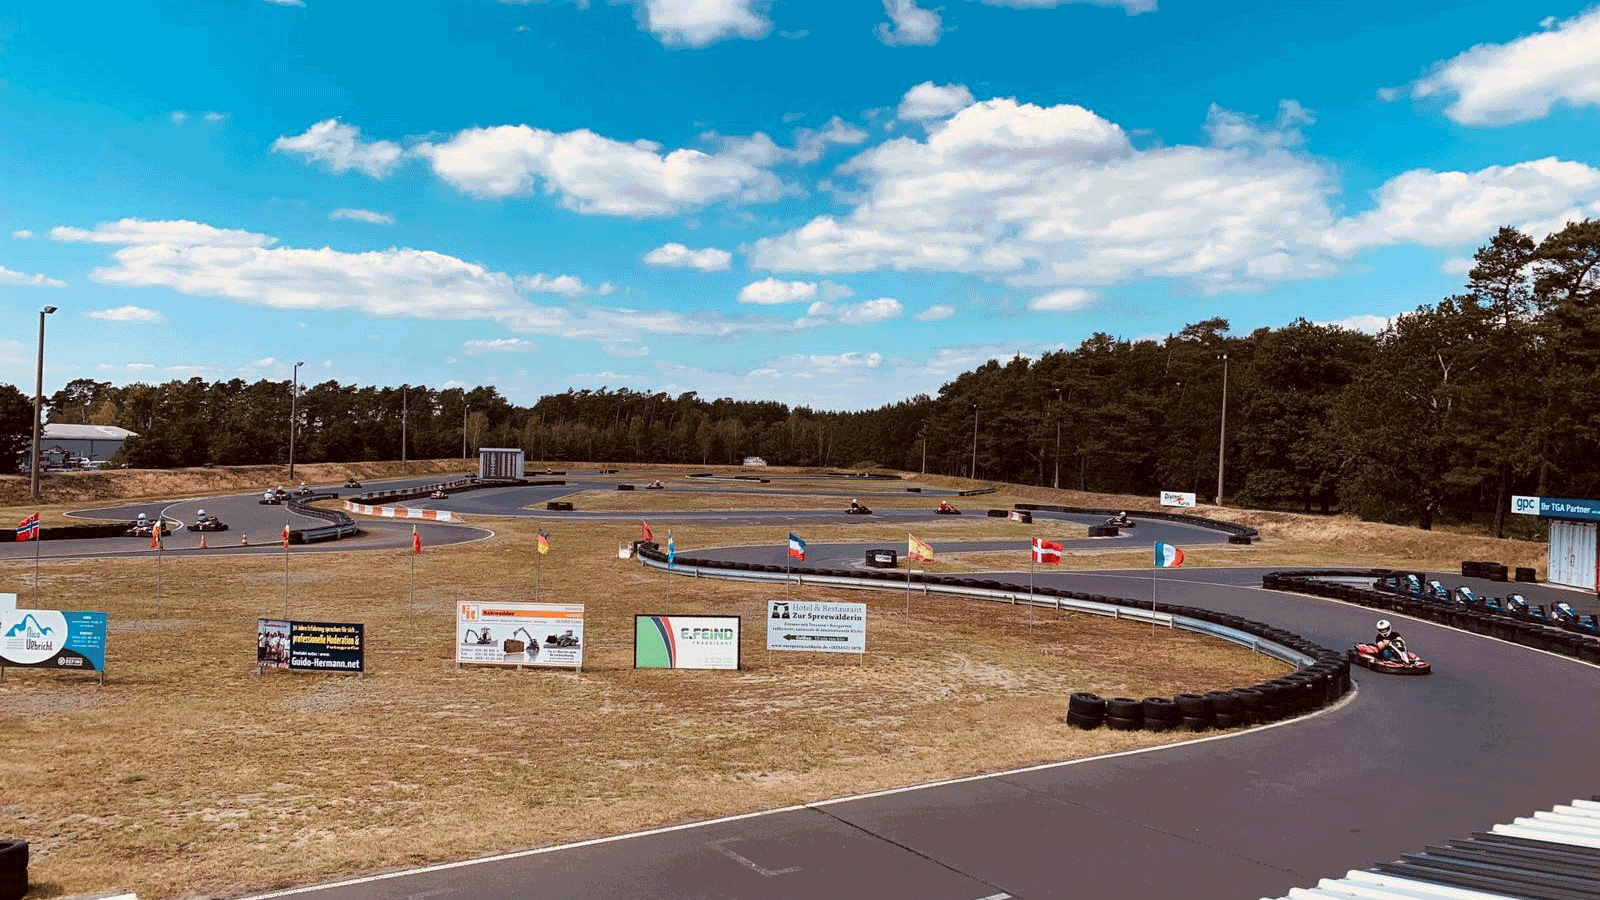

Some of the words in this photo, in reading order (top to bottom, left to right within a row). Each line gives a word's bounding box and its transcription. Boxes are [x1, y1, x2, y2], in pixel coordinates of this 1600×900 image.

[1516, 498, 1534, 511] gpc
[1541, 502, 1550, 510] Ihr
[1552, 503, 1565, 512] TGA
[1566, 504, 1591, 514] Partner
[822, 604, 862, 612] Restaurant
[27, 626, 40, 638] Nico
[292, 633, 326, 645] professionelle
[326, 634, 354, 645] Moderation
[355, 636, 359, 645] &
[292, 657, 360, 668] Guido-Hermann.net
